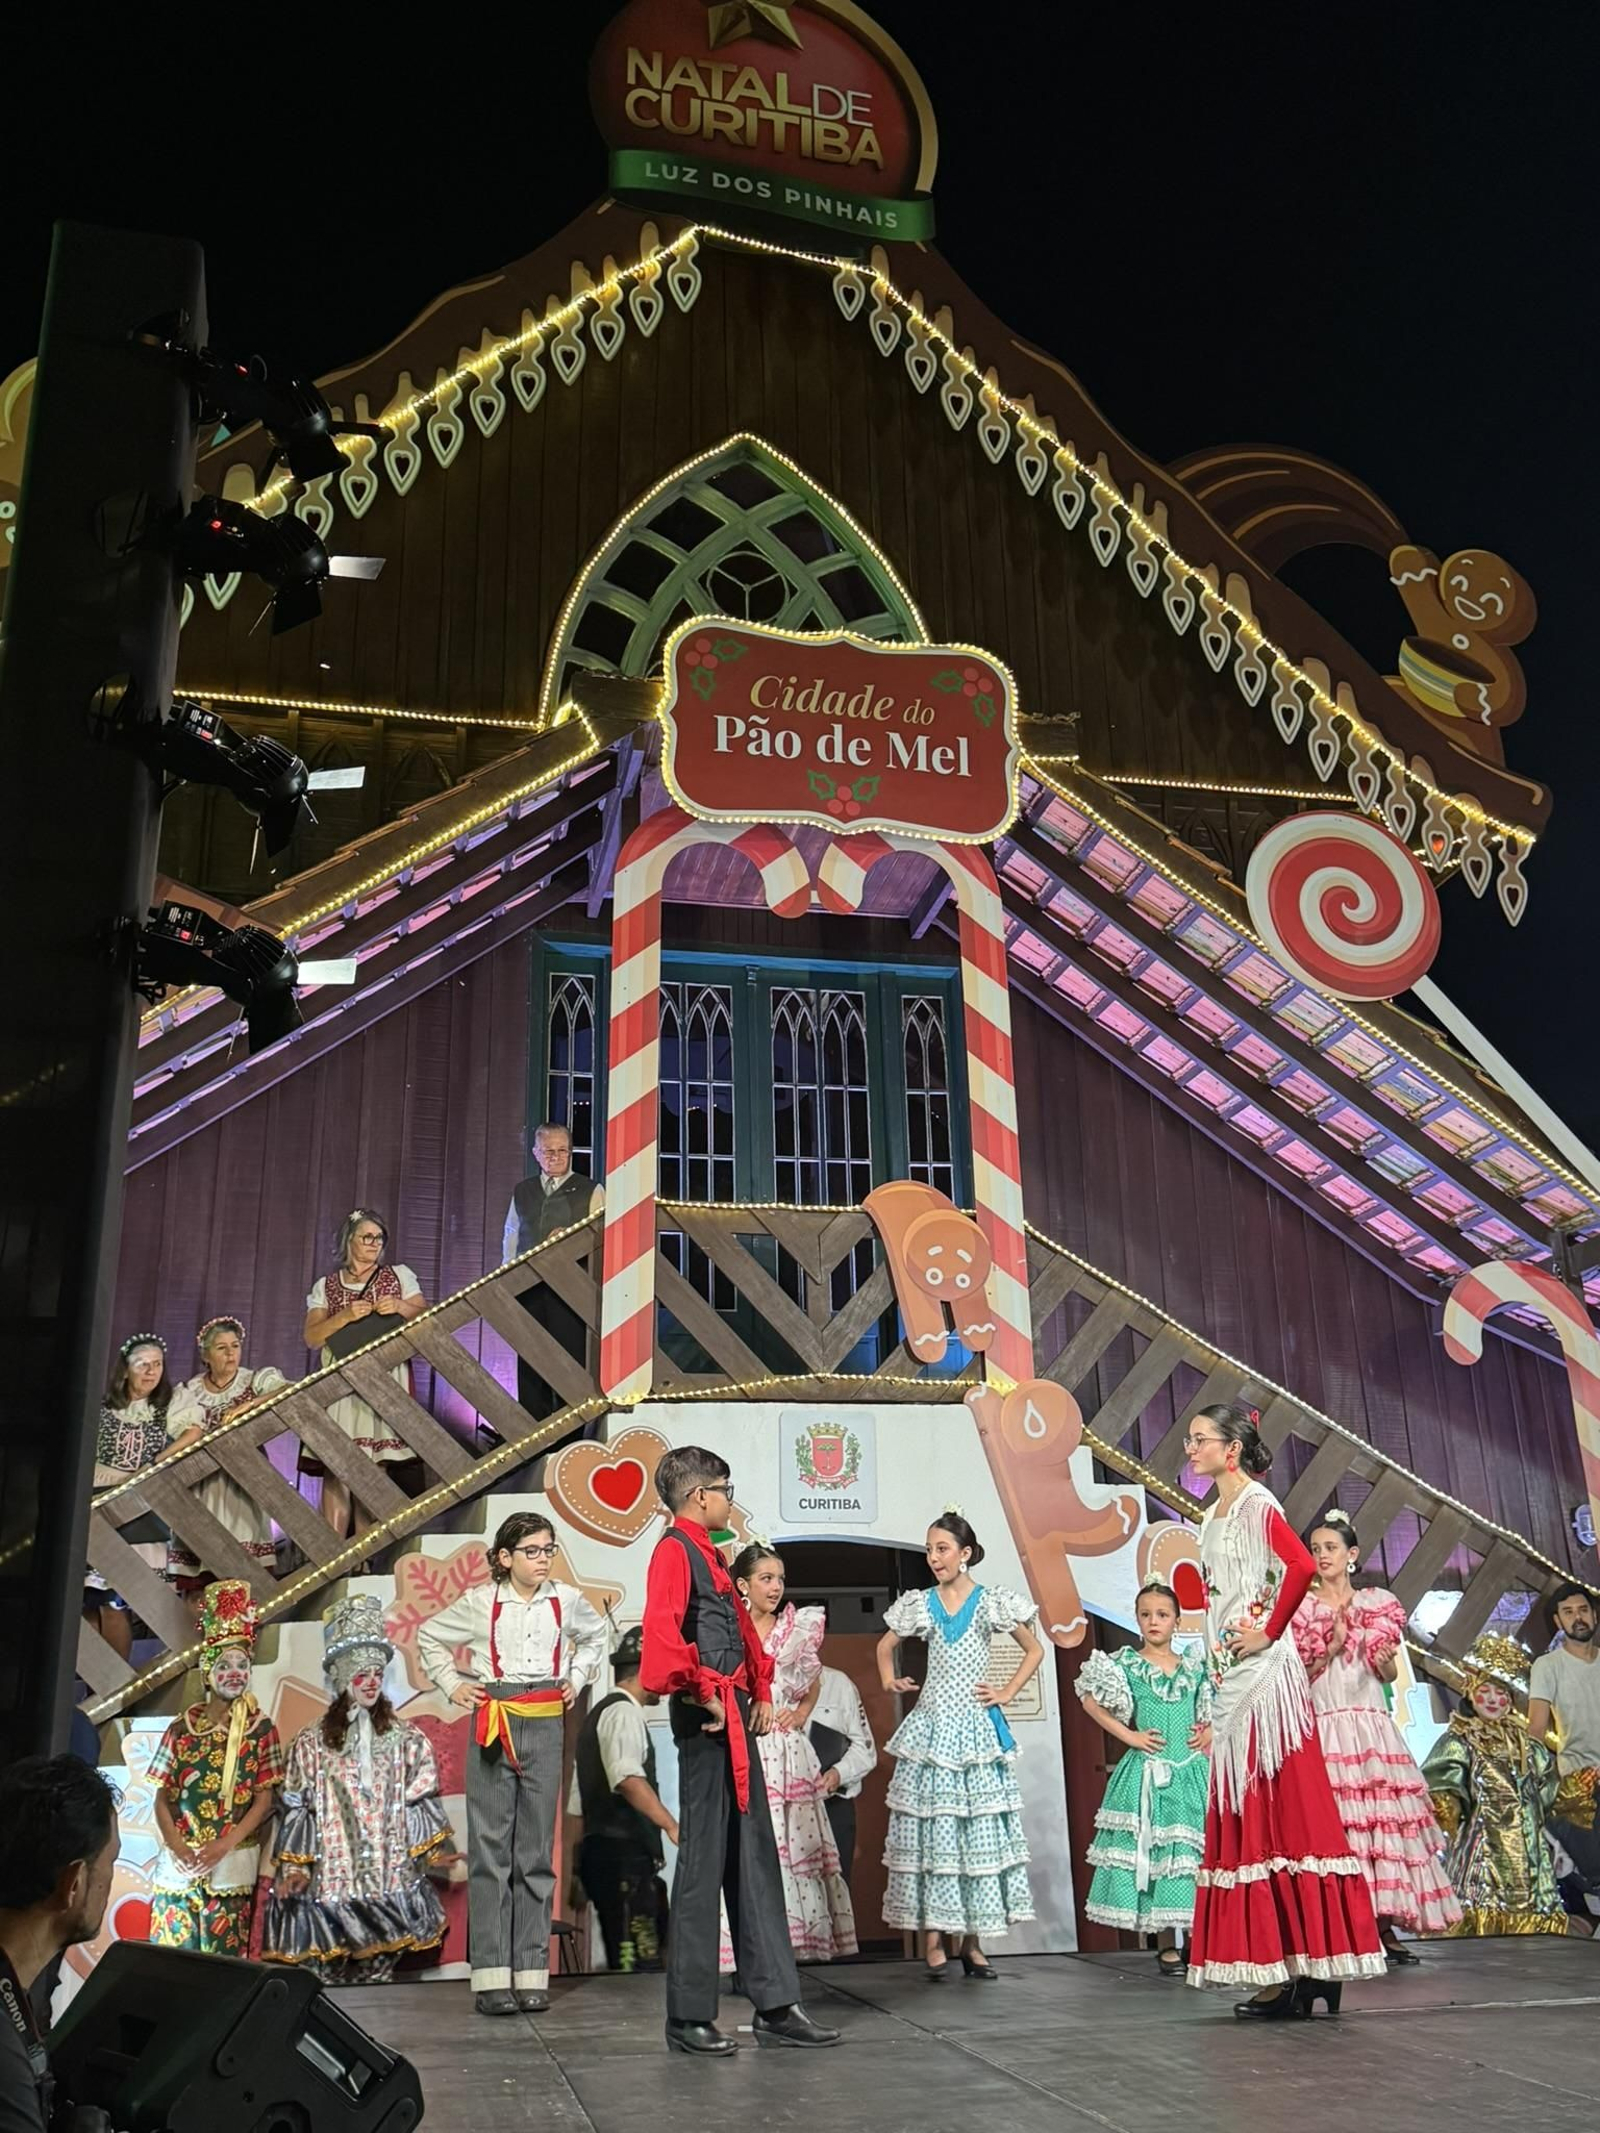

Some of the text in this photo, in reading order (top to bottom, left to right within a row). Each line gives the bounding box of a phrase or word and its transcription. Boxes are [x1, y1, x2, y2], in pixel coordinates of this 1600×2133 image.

[626, 47, 874, 128] NATAL DE
[625, 88, 885, 172] CURITIBA
[645, 162, 899, 229] LUZ DOS PINHAIS
[750, 674, 936, 727] Cidade do
[713, 714, 972, 778] Pão de Mel
[798, 1498, 862, 1510] CURITIBA
[0, 1977, 27, 2033] Canon
